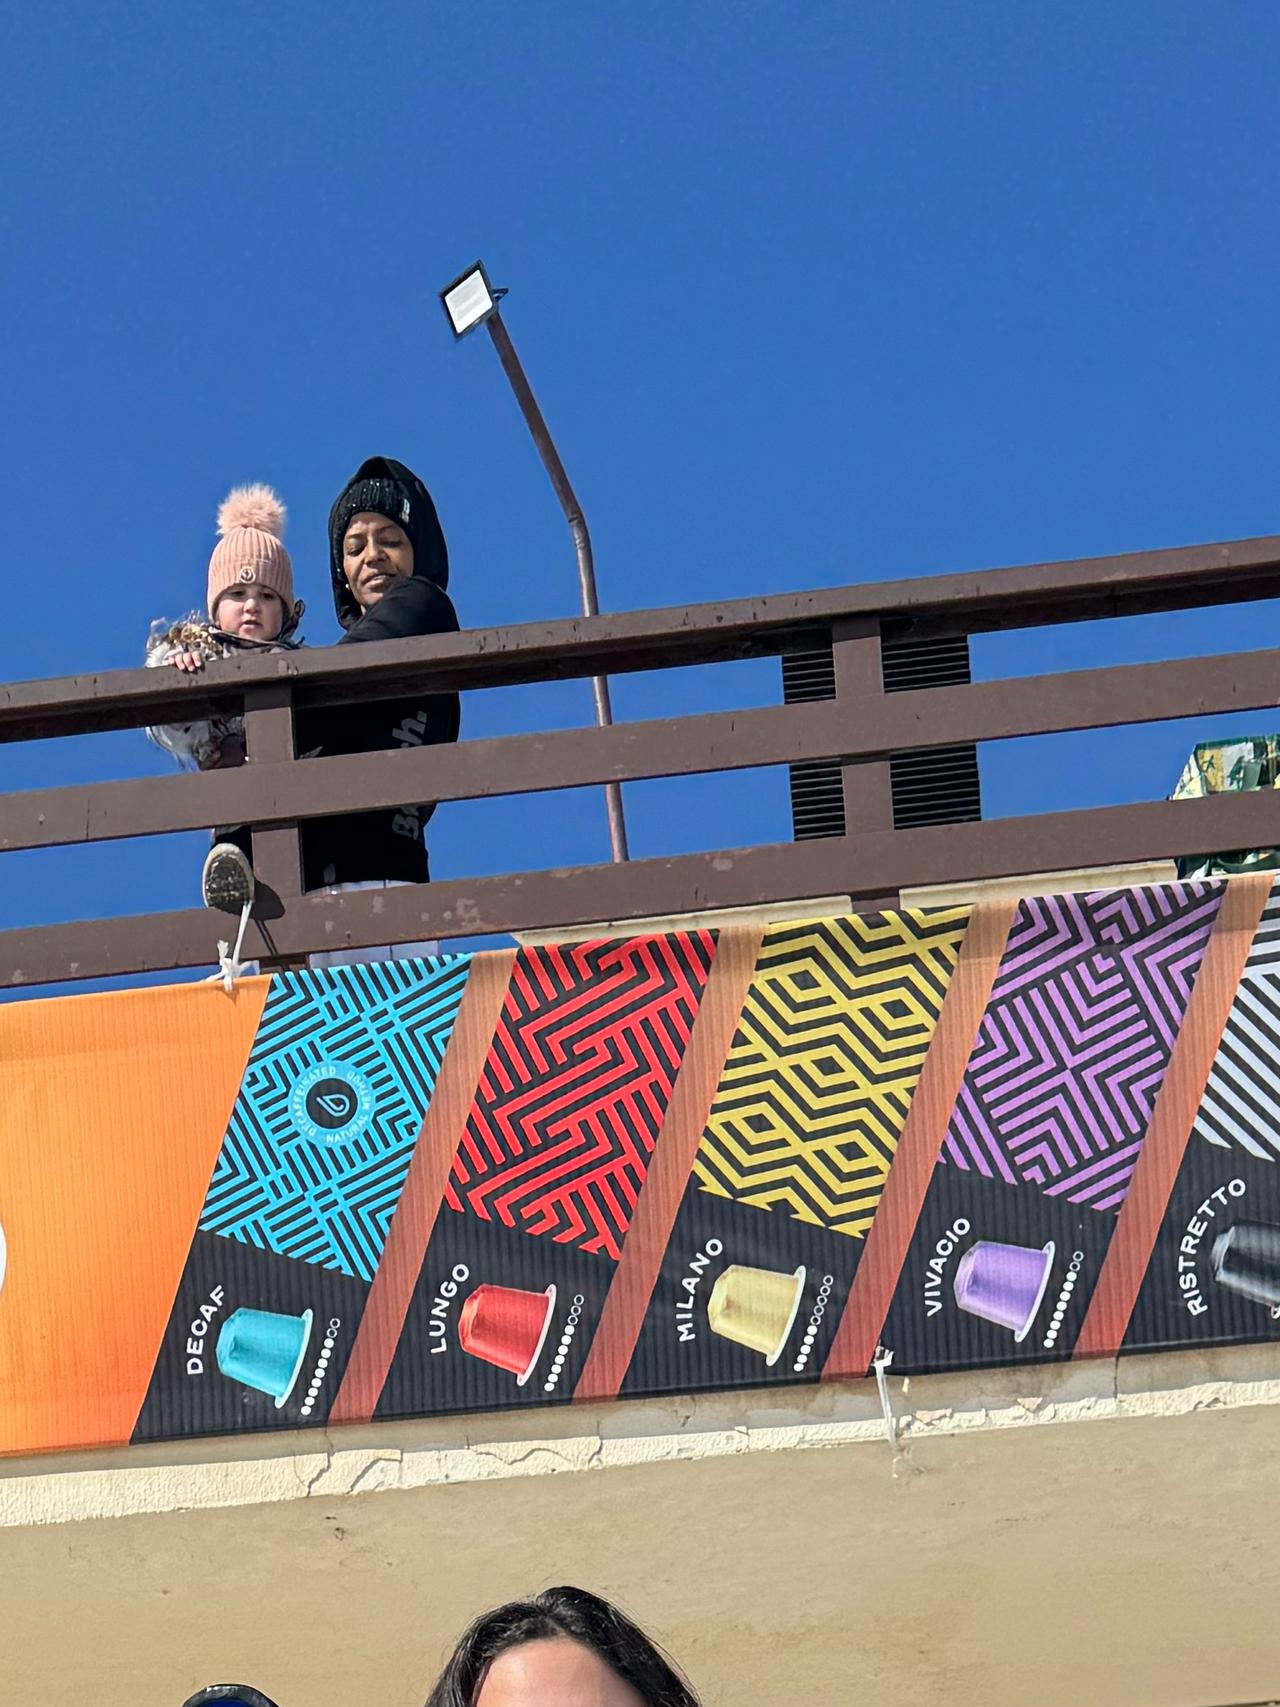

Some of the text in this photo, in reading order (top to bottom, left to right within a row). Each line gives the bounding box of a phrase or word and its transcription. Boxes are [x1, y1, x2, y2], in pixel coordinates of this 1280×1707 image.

[677, 1236, 724, 1344] MILANO
[922, 1216, 972, 1319] VIVACIO
[1177, 1176, 1248, 1318] RISTRETTO
[185, 1284, 227, 1376] DECAF
[429, 1262, 470, 1355] LUNGO
